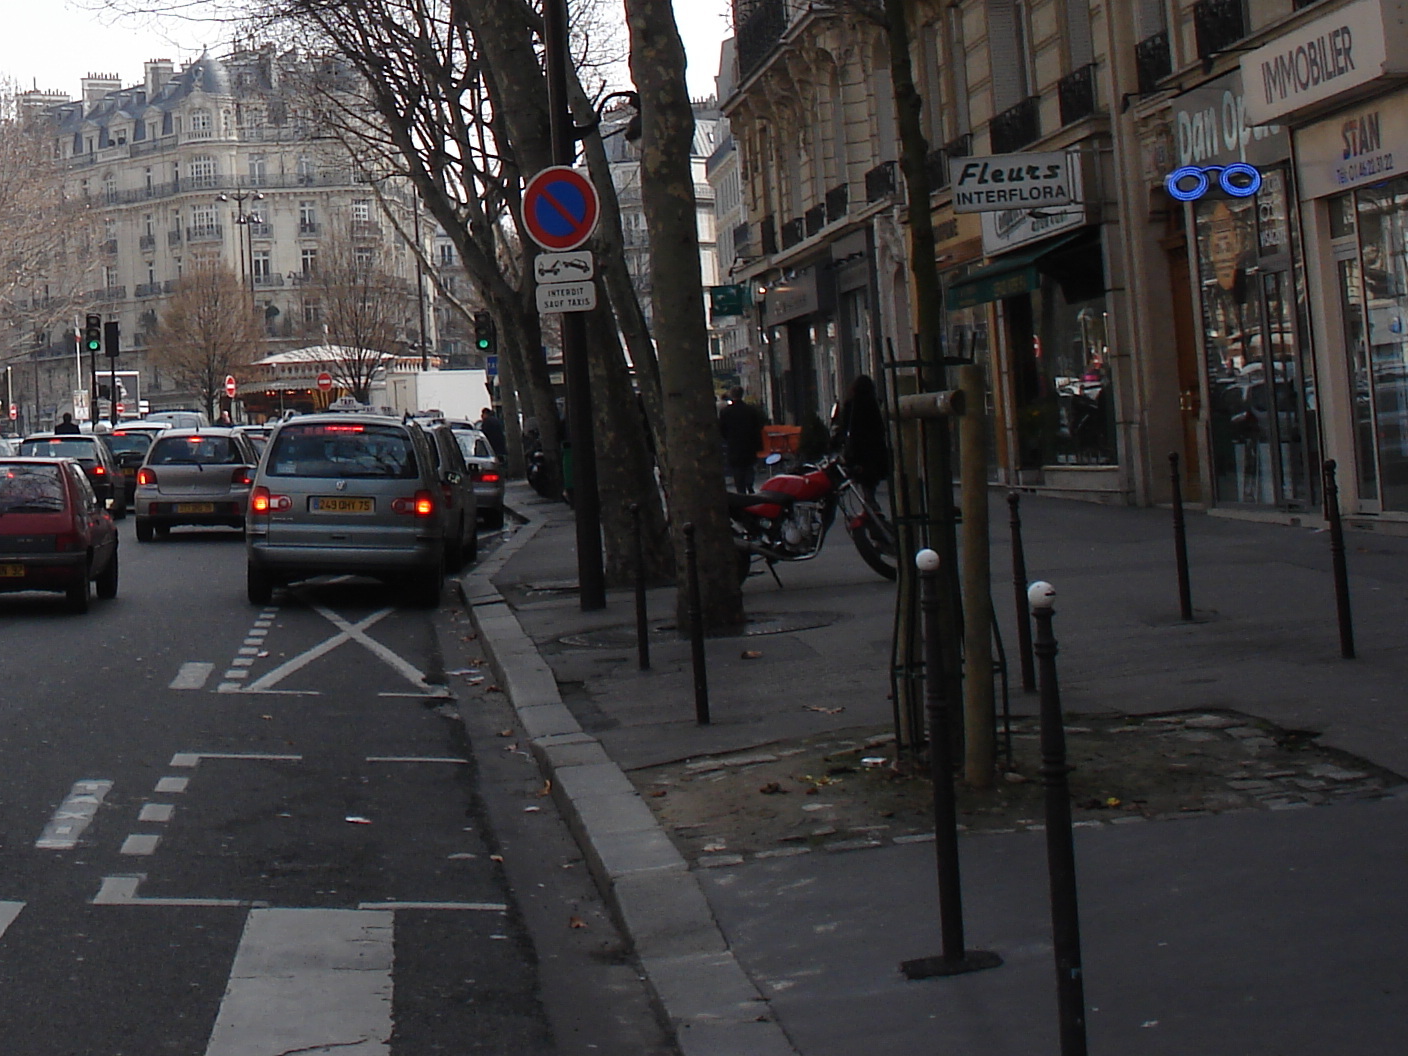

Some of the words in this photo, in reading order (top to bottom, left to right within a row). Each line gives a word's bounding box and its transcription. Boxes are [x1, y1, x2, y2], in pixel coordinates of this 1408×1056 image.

[1261, 26, 1355, 105] IMMOBILIER
[1177, 107, 1219, 166] Dan
[1341, 111, 1380, 160] STAN
[957, 162, 1061, 186] Fleurs
[956, 185, 1066, 205] INTERFLORA
[544, 300, 564, 309] SAUF
[568, 297, 590, 307] TAXIS
[548, 287, 584, 297] INTERDIT
[358, 500, 370, 511] 75
